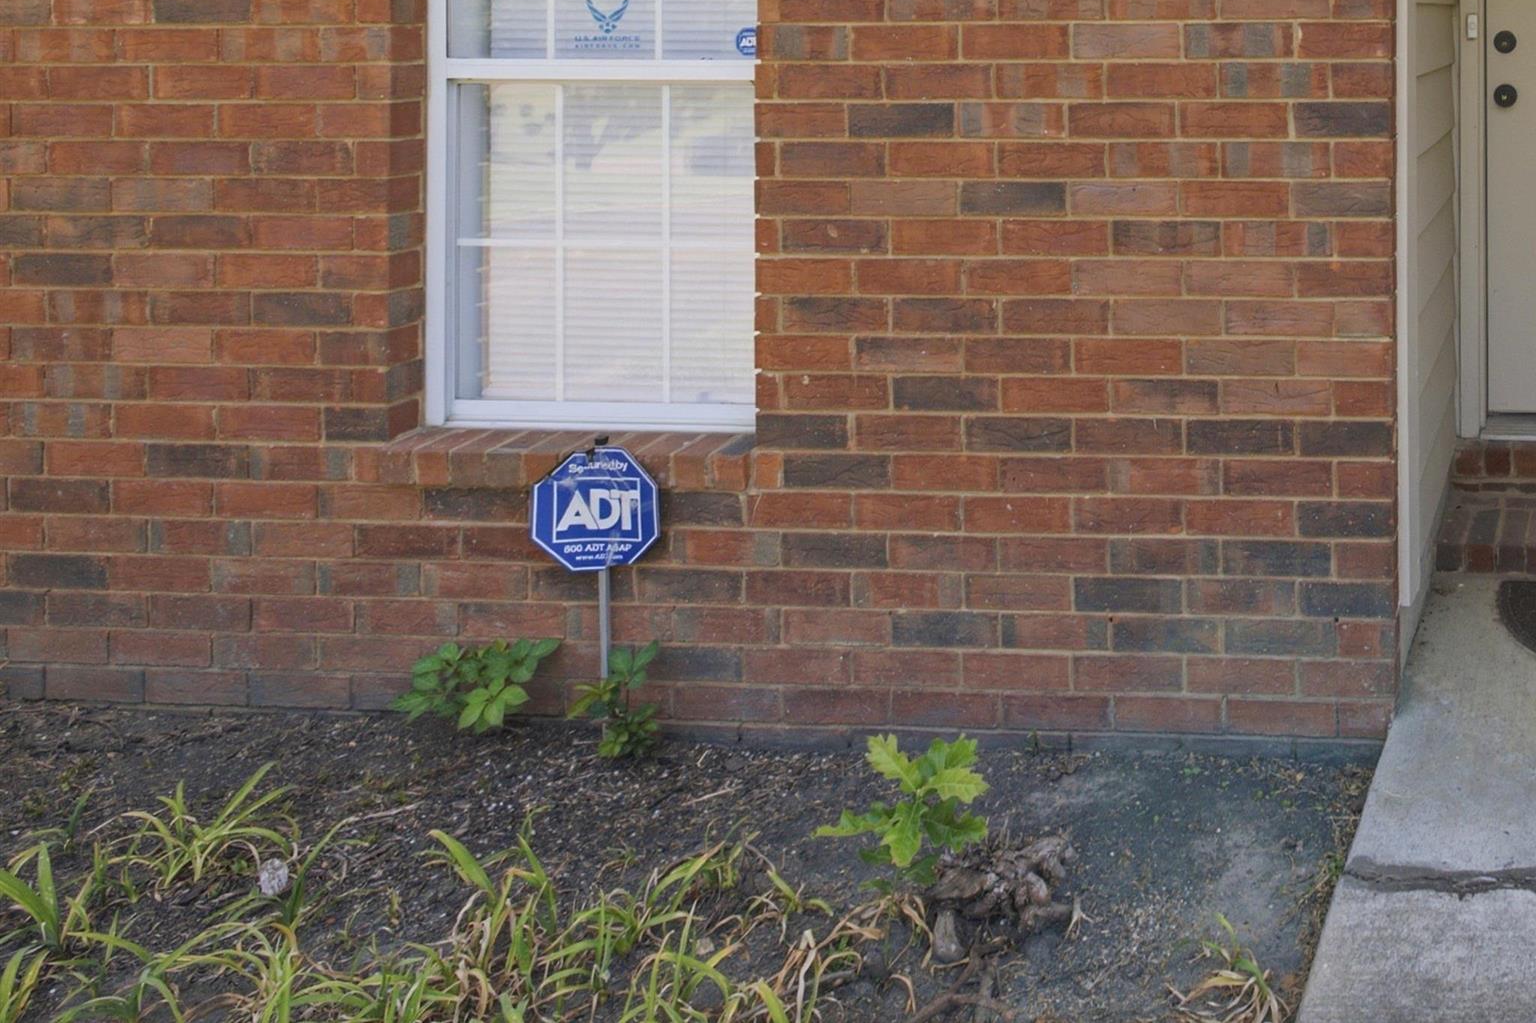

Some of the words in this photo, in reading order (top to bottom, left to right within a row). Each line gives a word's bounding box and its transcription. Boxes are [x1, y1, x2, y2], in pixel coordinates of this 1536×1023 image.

[556, 488, 641, 532] ADT
[563, 543, 583, 554] 800
[584, 543, 605, 552] ADT
